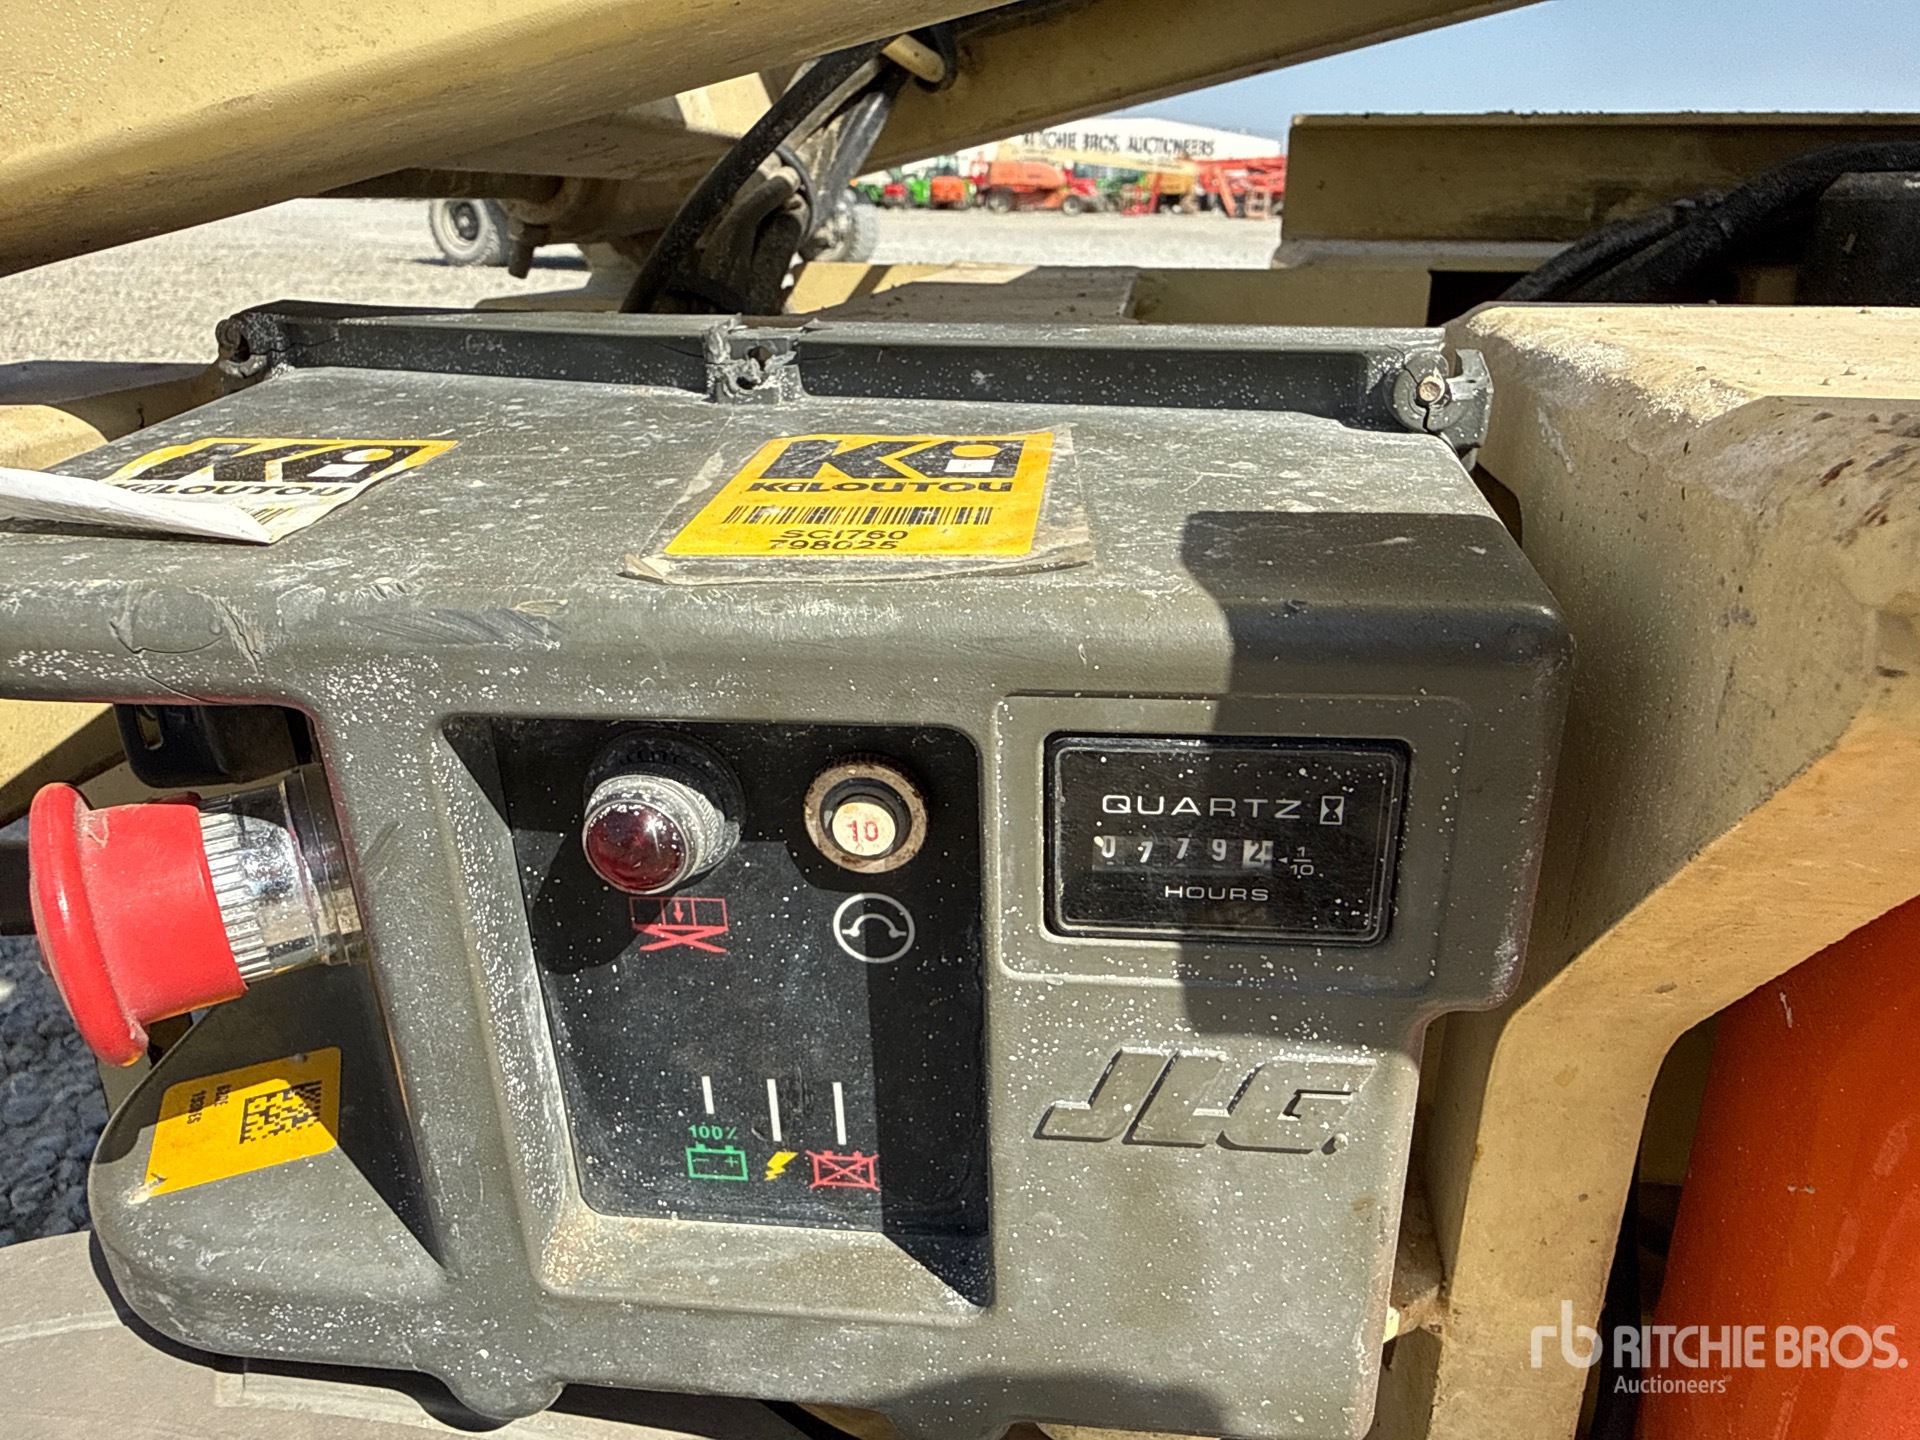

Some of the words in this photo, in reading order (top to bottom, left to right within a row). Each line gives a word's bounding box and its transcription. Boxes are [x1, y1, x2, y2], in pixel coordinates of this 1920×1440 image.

[1102, 794, 1301, 819] QUARTZ
[846, 820, 879, 842] 10
[1164, 885, 1269, 901] HOURS
[688, 1124, 738, 1141] 100%
